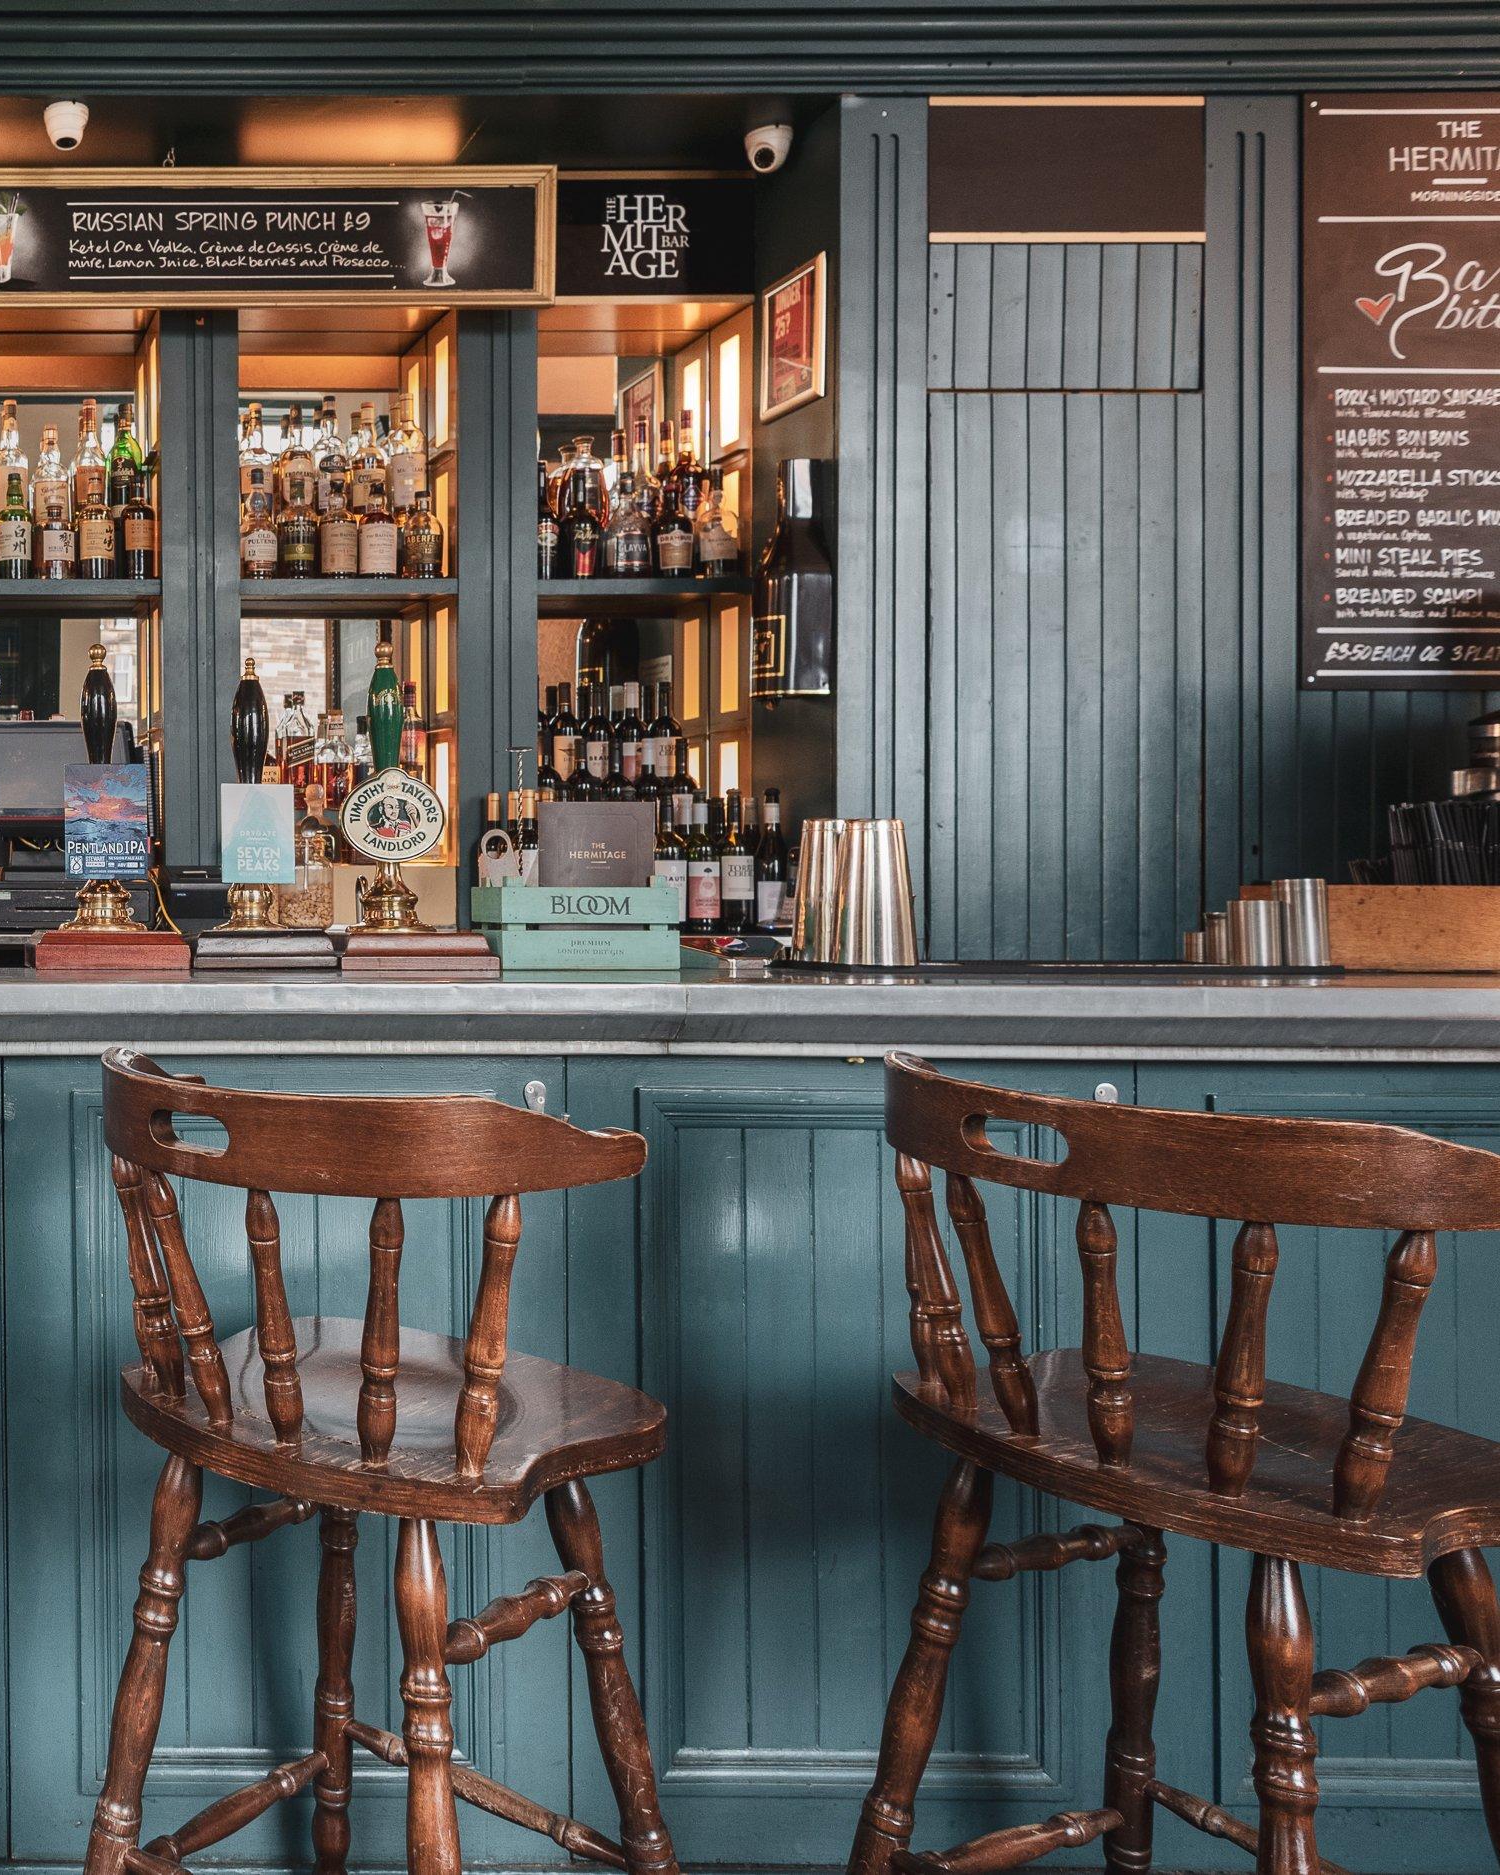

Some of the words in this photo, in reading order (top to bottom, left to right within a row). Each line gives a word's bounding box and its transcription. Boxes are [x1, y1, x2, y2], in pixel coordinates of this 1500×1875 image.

[1436, 120, 1483, 139] THE
[72, 212, 164, 232] RUSSIAN
[174, 212, 259, 232] SPRING
[266, 212, 336, 231] PUNCH
[344, 212, 372, 232] £9
[68, 239, 111, 255] Ketel
[112, 240, 144, 254] One
[199, 240, 244, 255] Crème
[248, 240, 267, 254] de
[318, 240, 359, 255] Crème
[362, 240, 384, 254] de
[661, 235, 691, 248] BAR
[107, 256, 155, 269] Lemon
[299, 255, 329, 269] and
[1334, 388, 1368, 407] PORK
[1379, 388, 1441, 406] MUSTARD
[1335, 428, 1391, 447] HAGGIS
[1335, 468, 1443, 487] MOZZARELLA
[1334, 508, 1411, 528] BREADED
[1416, 509, 1474, 528] GARLIC
[284, 525, 316, 534] TOMATIN
[246, 549, 258, 557] 12
[1335, 547, 1372, 565] MINI
[1376, 547, 1437, 566] STEAK
[1440, 548, 1484, 566] PIES
[1335, 587, 1418, 605] BREADED
[1422, 587, 1484, 605] SCAMPI
[349, 782, 386, 824] TIMOTHY
[400, 782, 438, 824] TAYLOR'S
[362, 830, 427, 852] LANDLORD
[236, 846, 281, 859] SEVEN
[569, 850, 627, 860] HERMITAGE
[237, 858, 281, 871] PEAKS
[550, 894, 633, 916] BLOOM
[570, 939, 612, 948] PREMIUM
